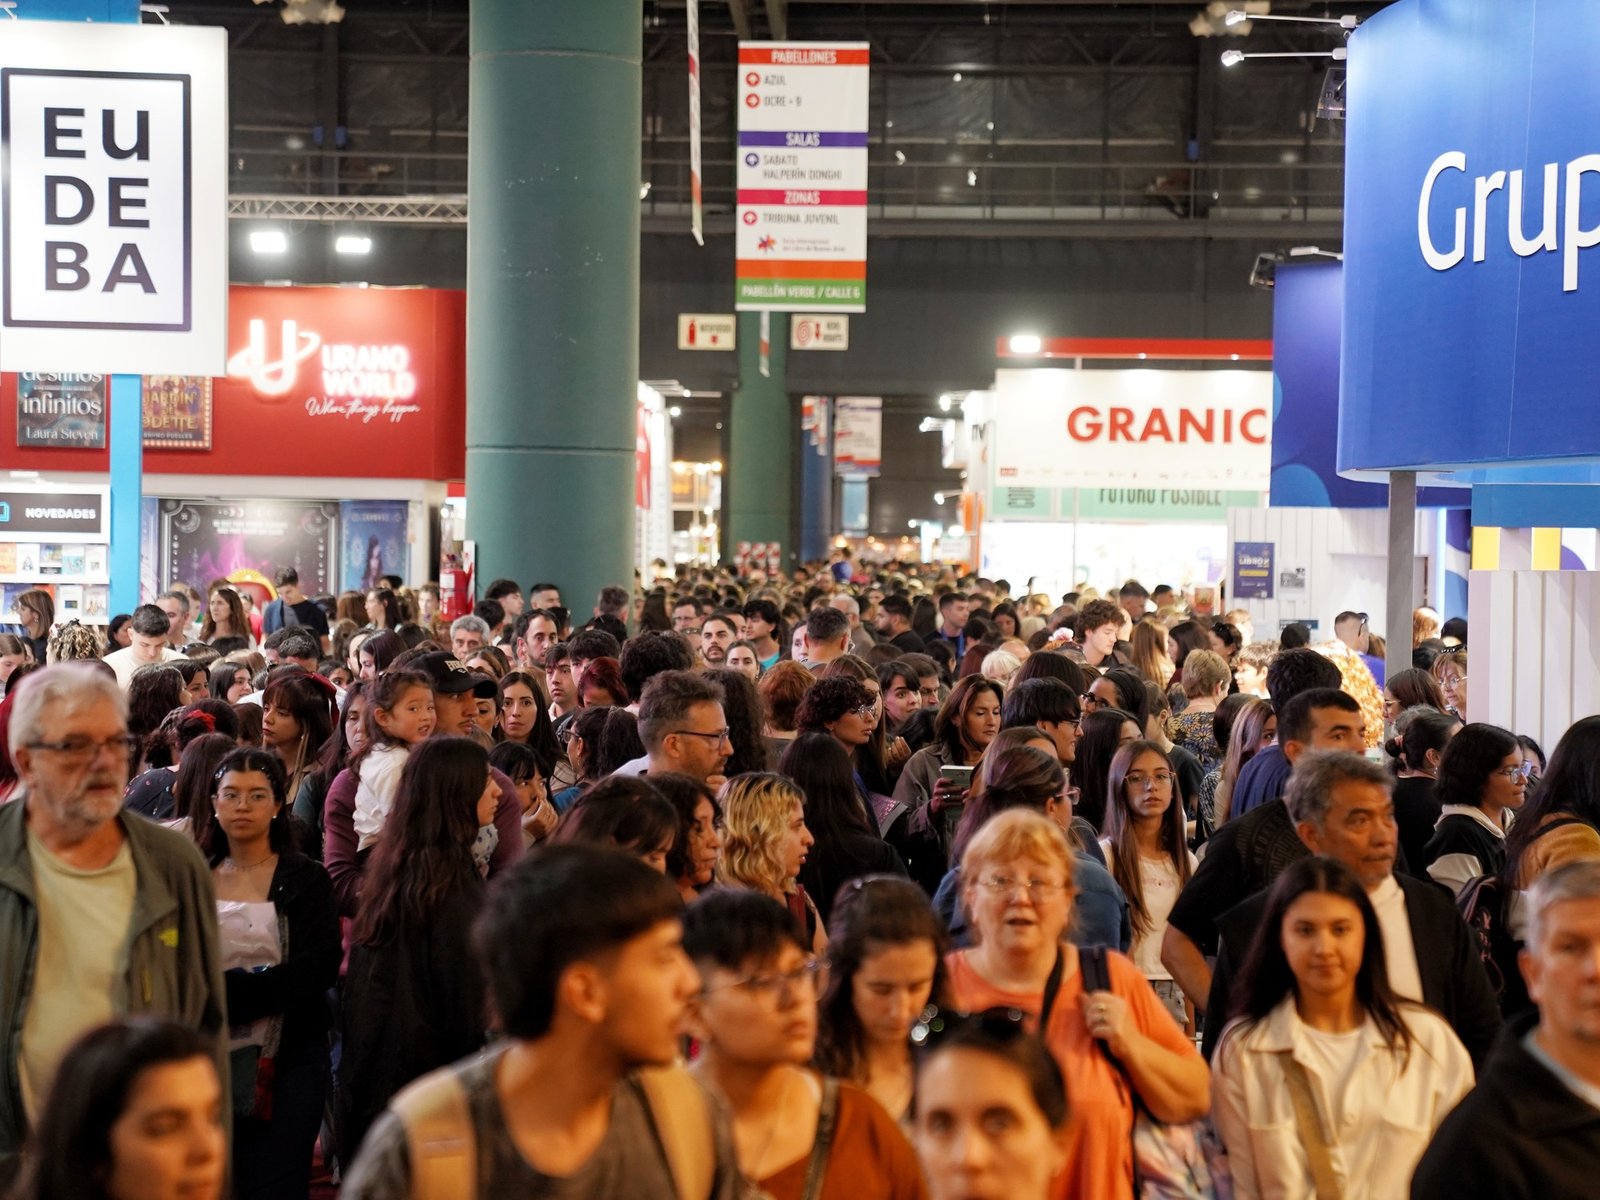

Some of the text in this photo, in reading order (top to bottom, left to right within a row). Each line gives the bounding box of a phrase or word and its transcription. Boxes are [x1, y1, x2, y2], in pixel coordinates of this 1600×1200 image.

[771, 50, 837, 64] PABELLONES
[764, 75, 786, 86] AZUL
[764, 97, 786, 107] OCRE
[785, 132, 821, 146] SALAS
[763, 155, 798, 165] SABATO
[809, 170, 842, 180] DONGHI
[44, 175, 151, 229] DE
[784, 190, 821, 205] ZONAS
[763, 213, 840, 225] TRIBUNA JUVENIL
[44, 240, 158, 295] BA
[787, 286, 816, 298] VERDE
[824, 286, 852, 298] CALLE
[321, 344, 410, 371] URANO
[322, 370, 417, 398] WORLD
[23, 392, 102, 415] infinitos
[27, 426, 98, 440] Laura Steven
[25, 508, 97, 519] NOVEDADES
